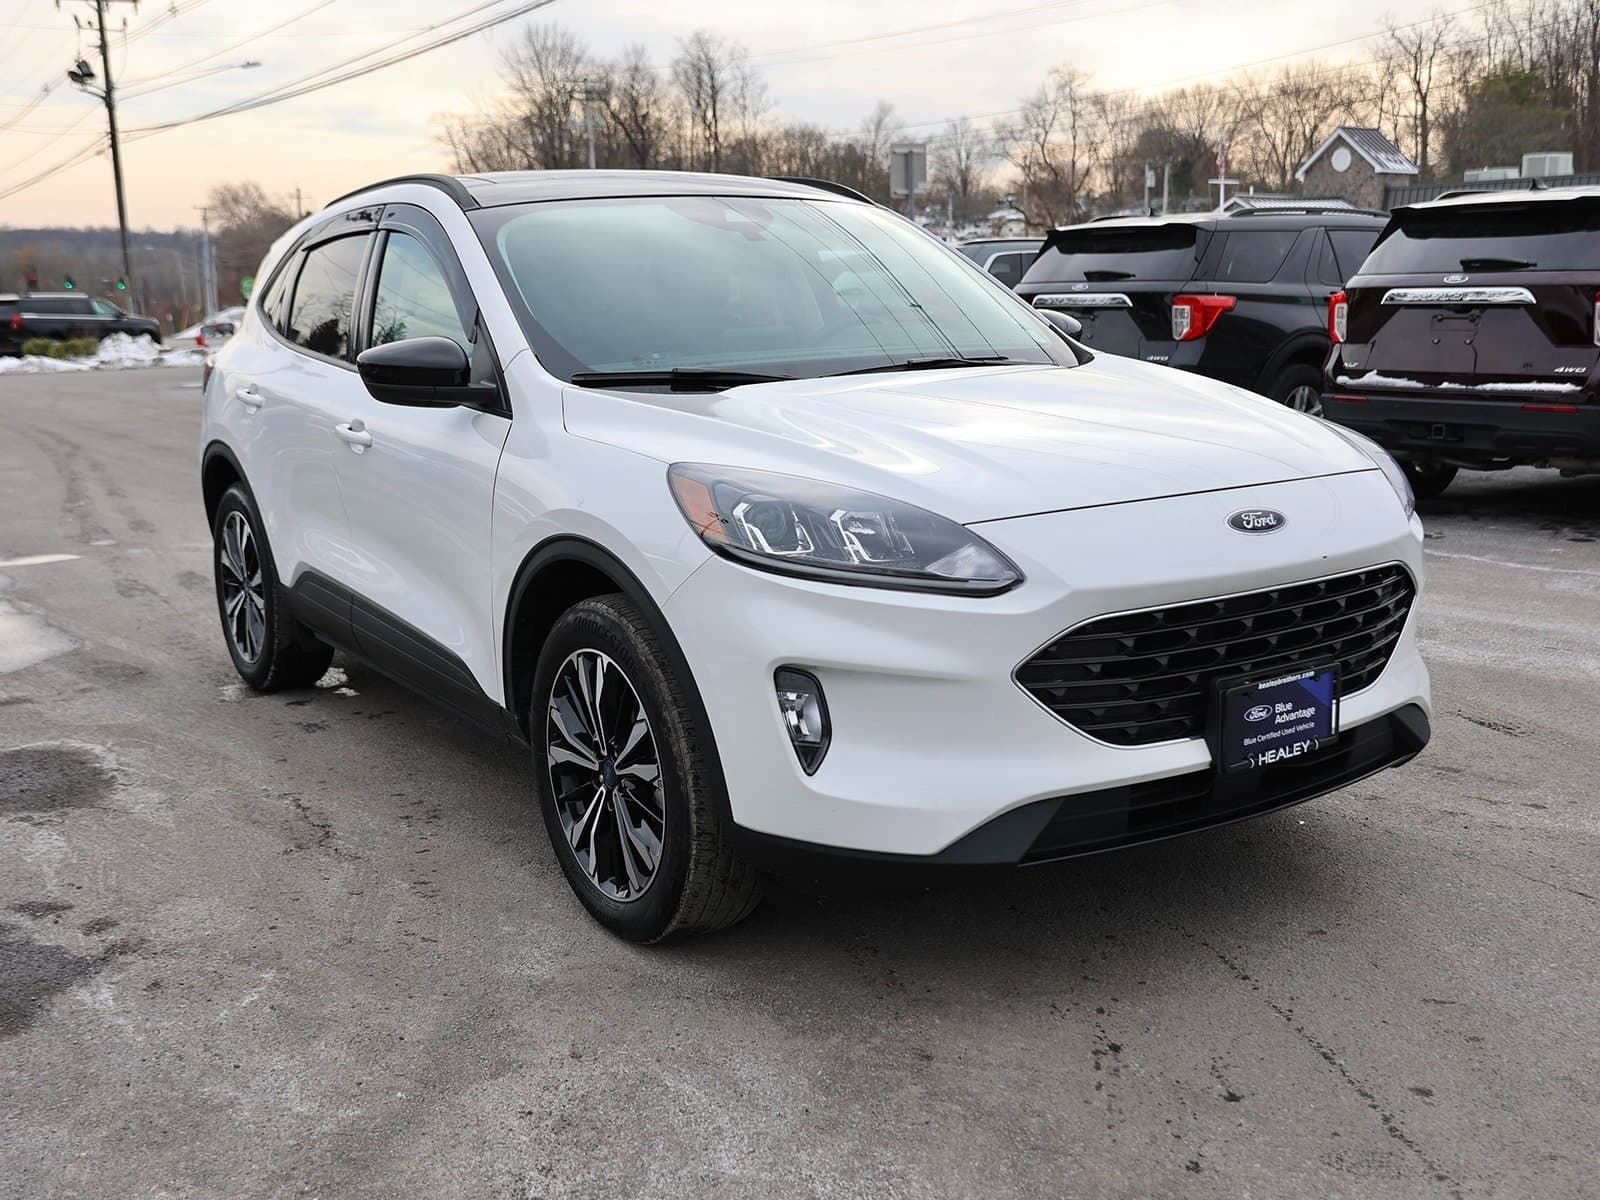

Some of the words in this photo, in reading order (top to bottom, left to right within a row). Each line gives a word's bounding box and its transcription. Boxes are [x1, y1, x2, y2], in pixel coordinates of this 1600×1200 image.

[1553, 366, 1588, 375] 4WD
[1240, 511, 1278, 529] Ford
[574, 615, 640, 676] BRIDGESTON
[1274, 702, 1294, 714] Blue
[1274, 706, 1317, 725] Advantage
[1243, 737, 1257, 746] Blue
[1257, 730, 1281, 743] Certified
[1281, 726, 1296, 736] Used
[1296, 721, 1316, 732] Vehicle
[1258, 739, 1311, 766] HEALEY
